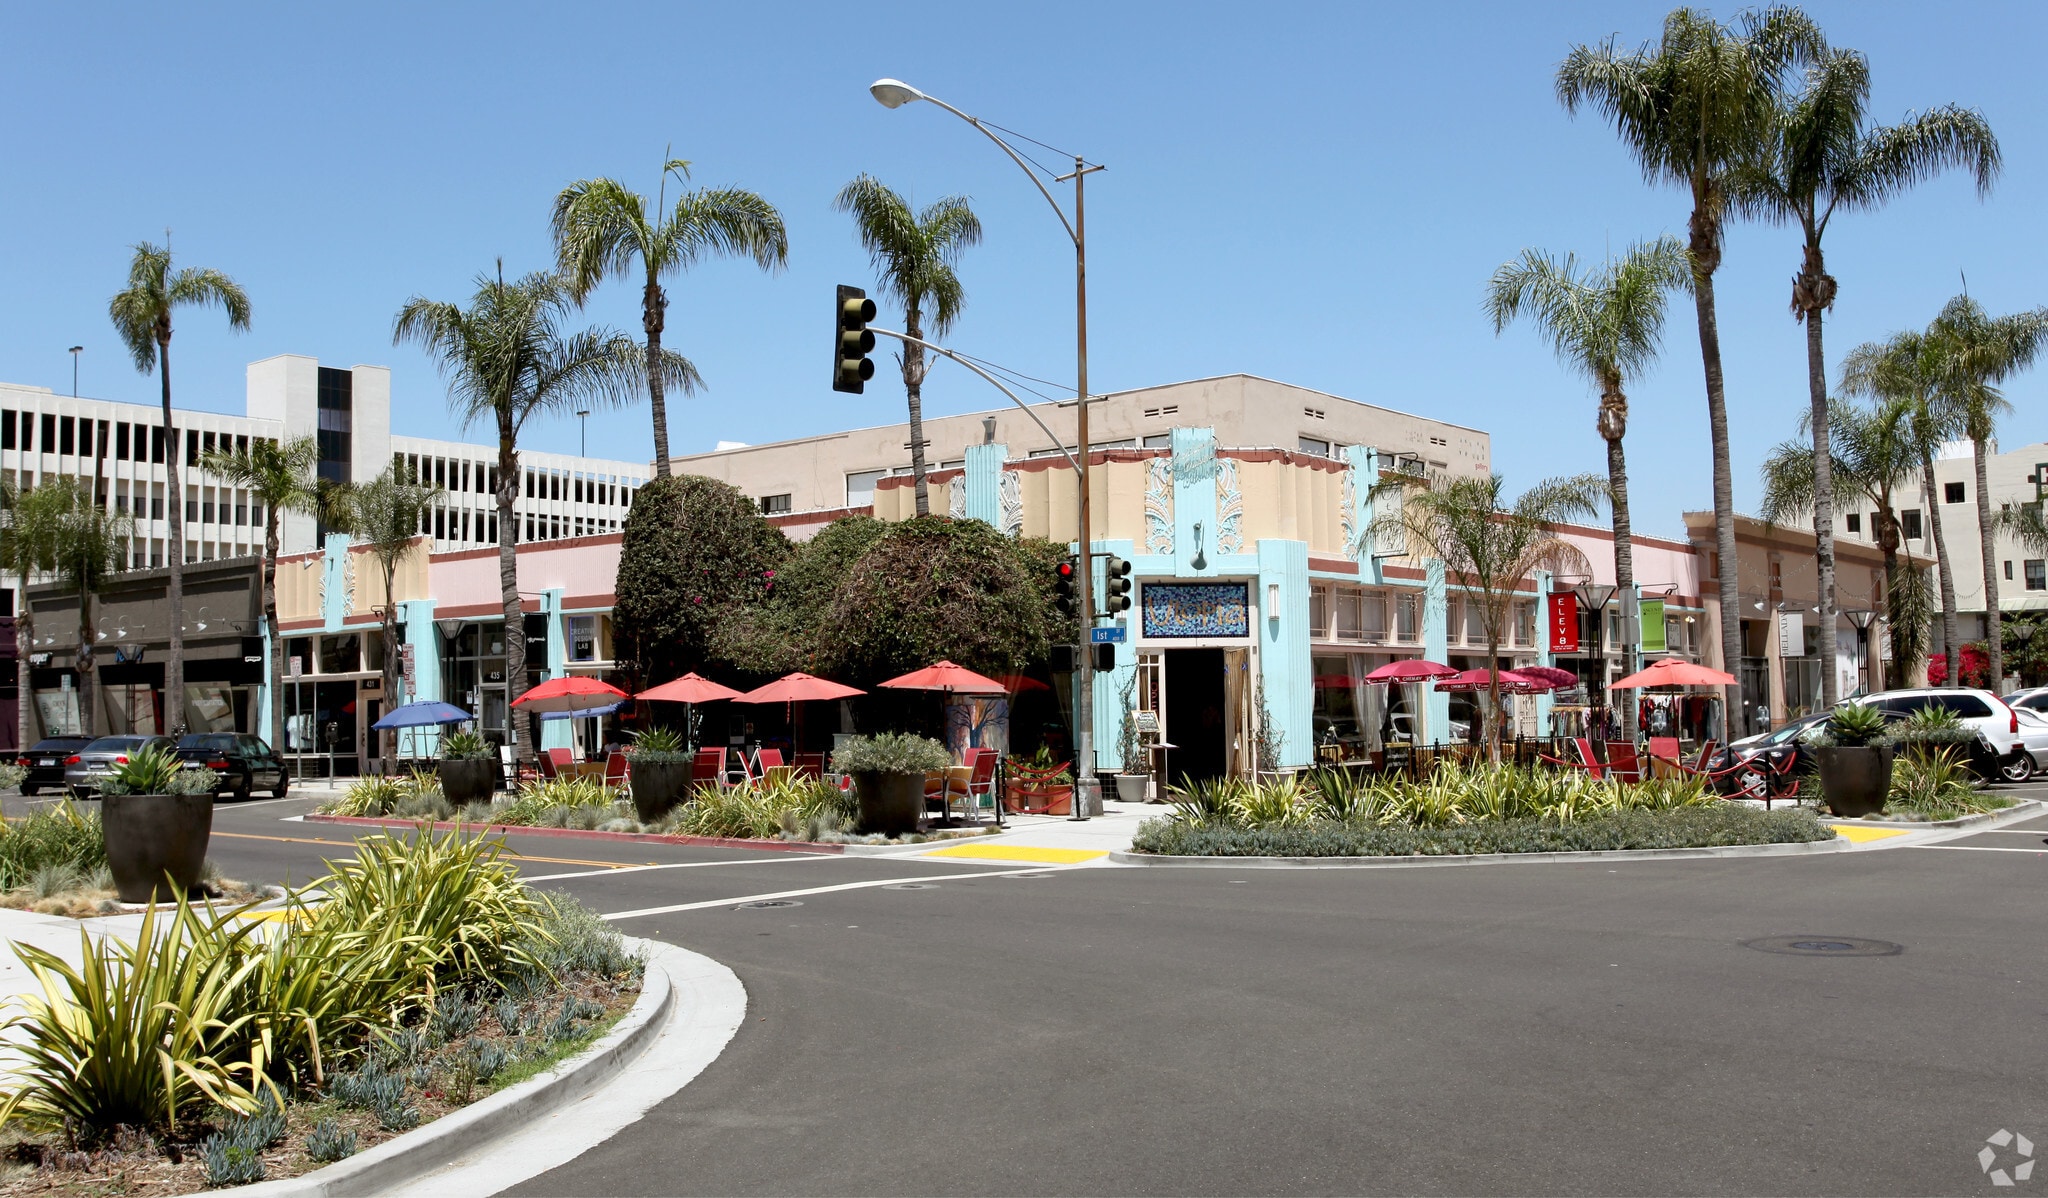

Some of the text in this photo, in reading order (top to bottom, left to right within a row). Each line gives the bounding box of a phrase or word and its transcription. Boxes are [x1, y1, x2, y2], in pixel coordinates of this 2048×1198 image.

[1147, 597, 1244, 627] Utopia
[1558, 598, 1566, 645] ELEV8
[1097, 630, 1108, 640] 1st
[490, 671, 500, 680] 435
